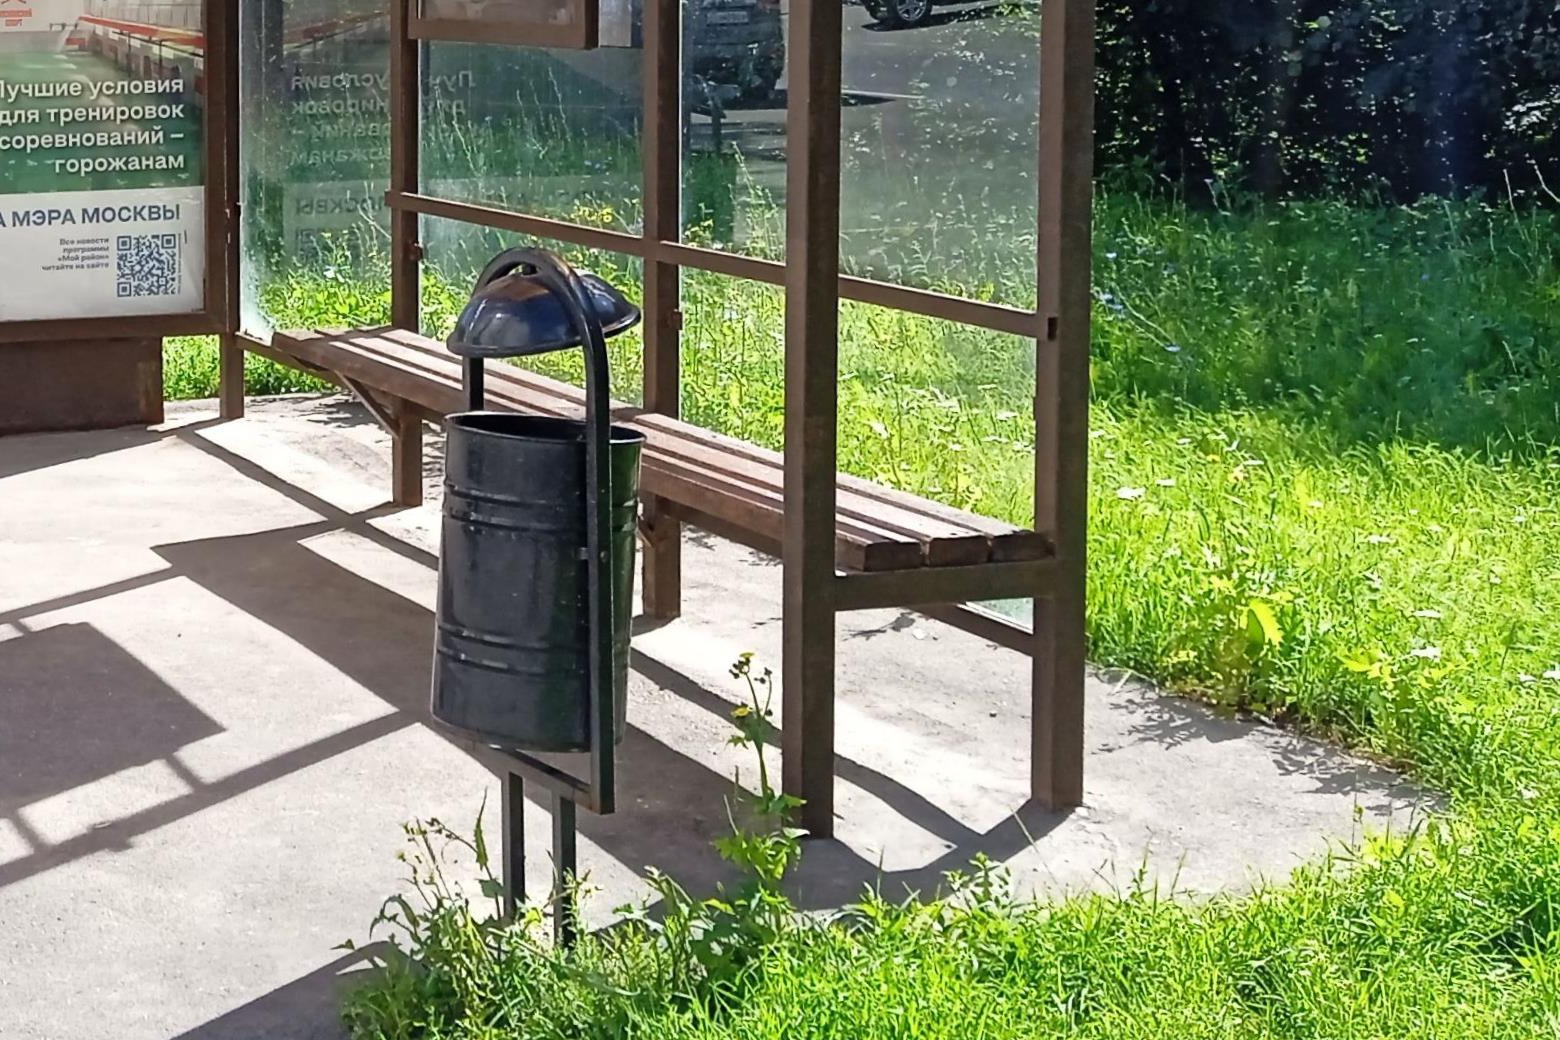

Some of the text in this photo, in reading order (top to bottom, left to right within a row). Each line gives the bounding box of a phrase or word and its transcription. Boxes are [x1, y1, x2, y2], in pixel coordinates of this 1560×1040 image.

[89, 78, 184, 99] условия
[46, 104, 184, 126] тренировок
[55, 155, 184, 176] горожанам
[11, 209, 77, 228] МЭРА
[81, 204, 181, 225] МОСКВЫ
